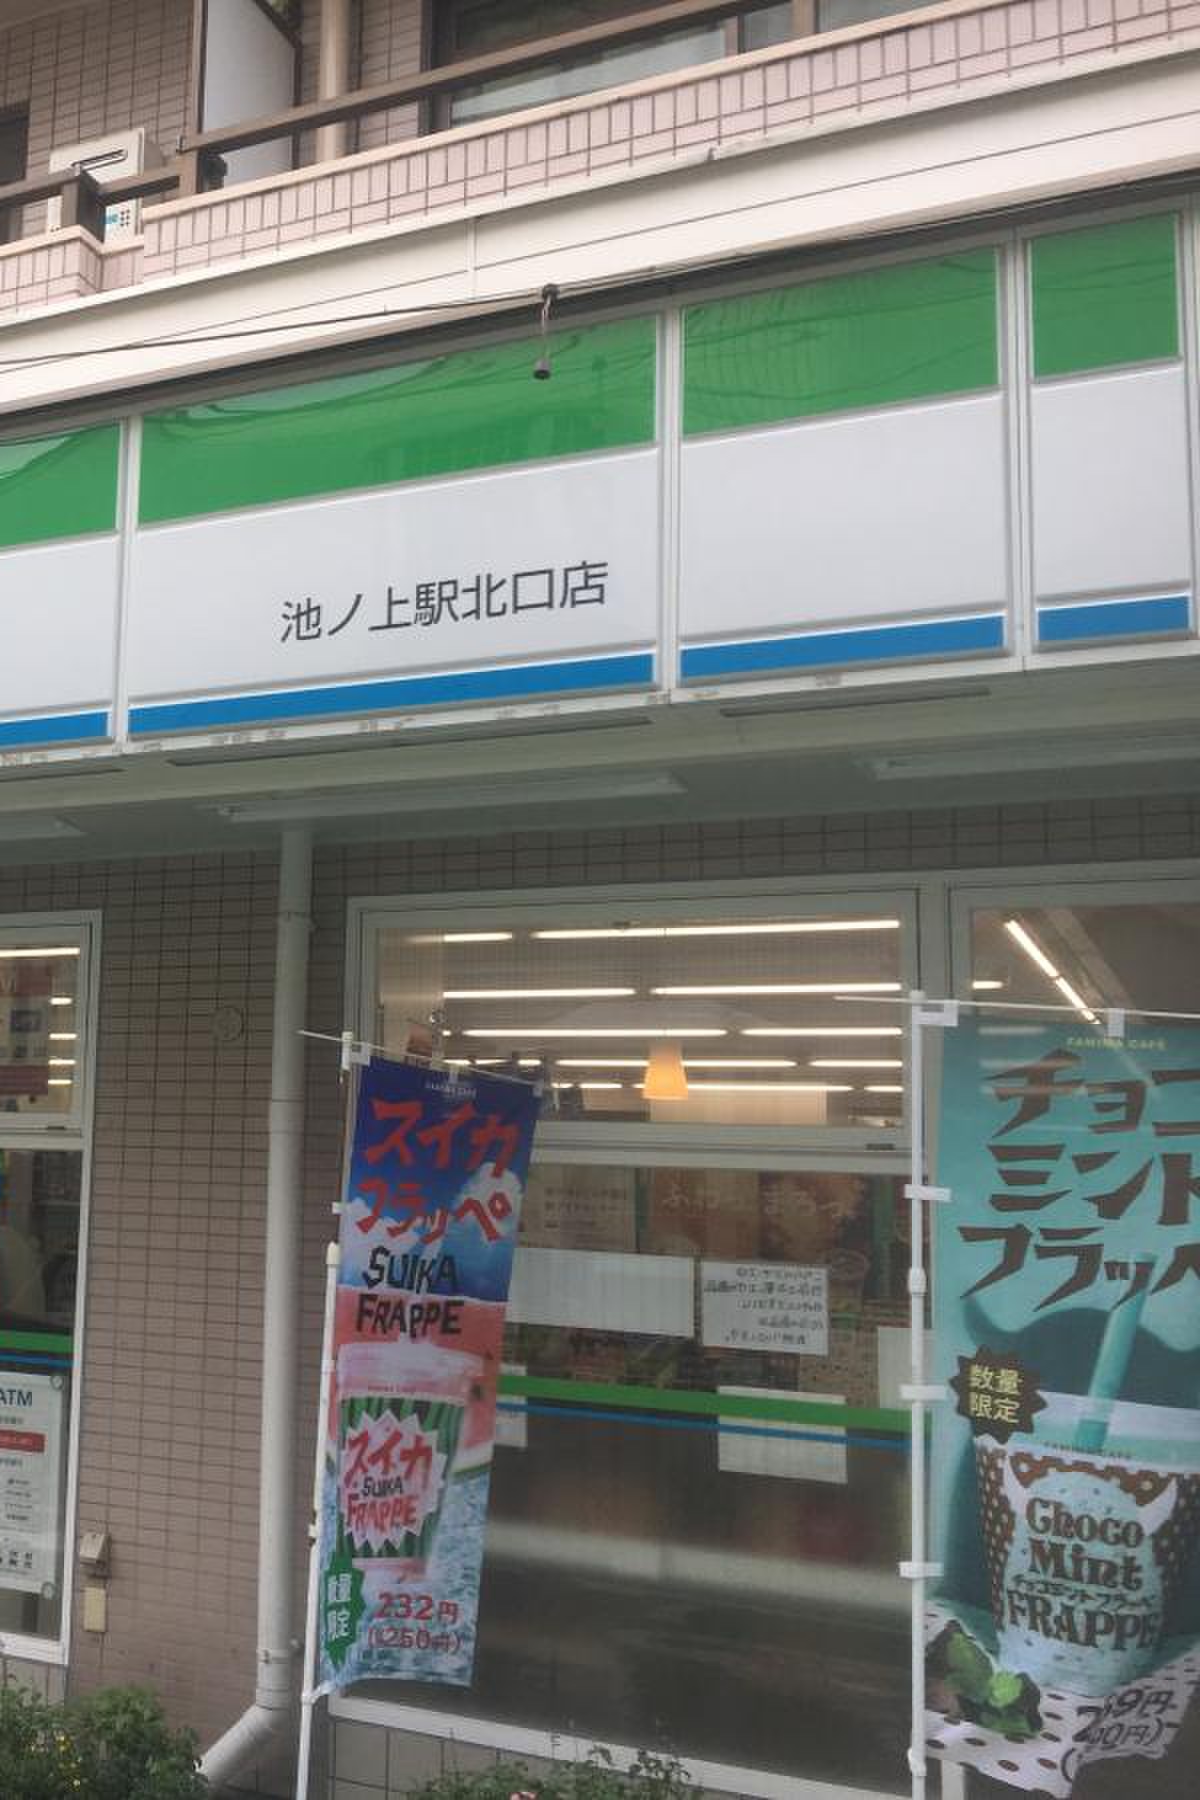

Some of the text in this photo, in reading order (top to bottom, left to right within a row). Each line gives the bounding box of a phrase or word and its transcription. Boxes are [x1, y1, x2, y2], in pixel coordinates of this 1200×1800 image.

[281, 561, 608, 642] 池ノ上駅北口店
[364, 1097, 519, 1178] スイカ
[356, 1178, 512, 1245] フラッペ
[362, 1246, 458, 1293] SUIKA
[356, 1293, 465, 1338] FRAPPE
[969, 1364, 1023, 1396] 数量
[969, 1394, 1020, 1425] 限定
[346, 1428, 433, 1488] スイカ
[1025, 1496, 1144, 1549] Choco
[1028, 1537, 1144, 1591] Mint
[375, 1592, 459, 1624] 232円
